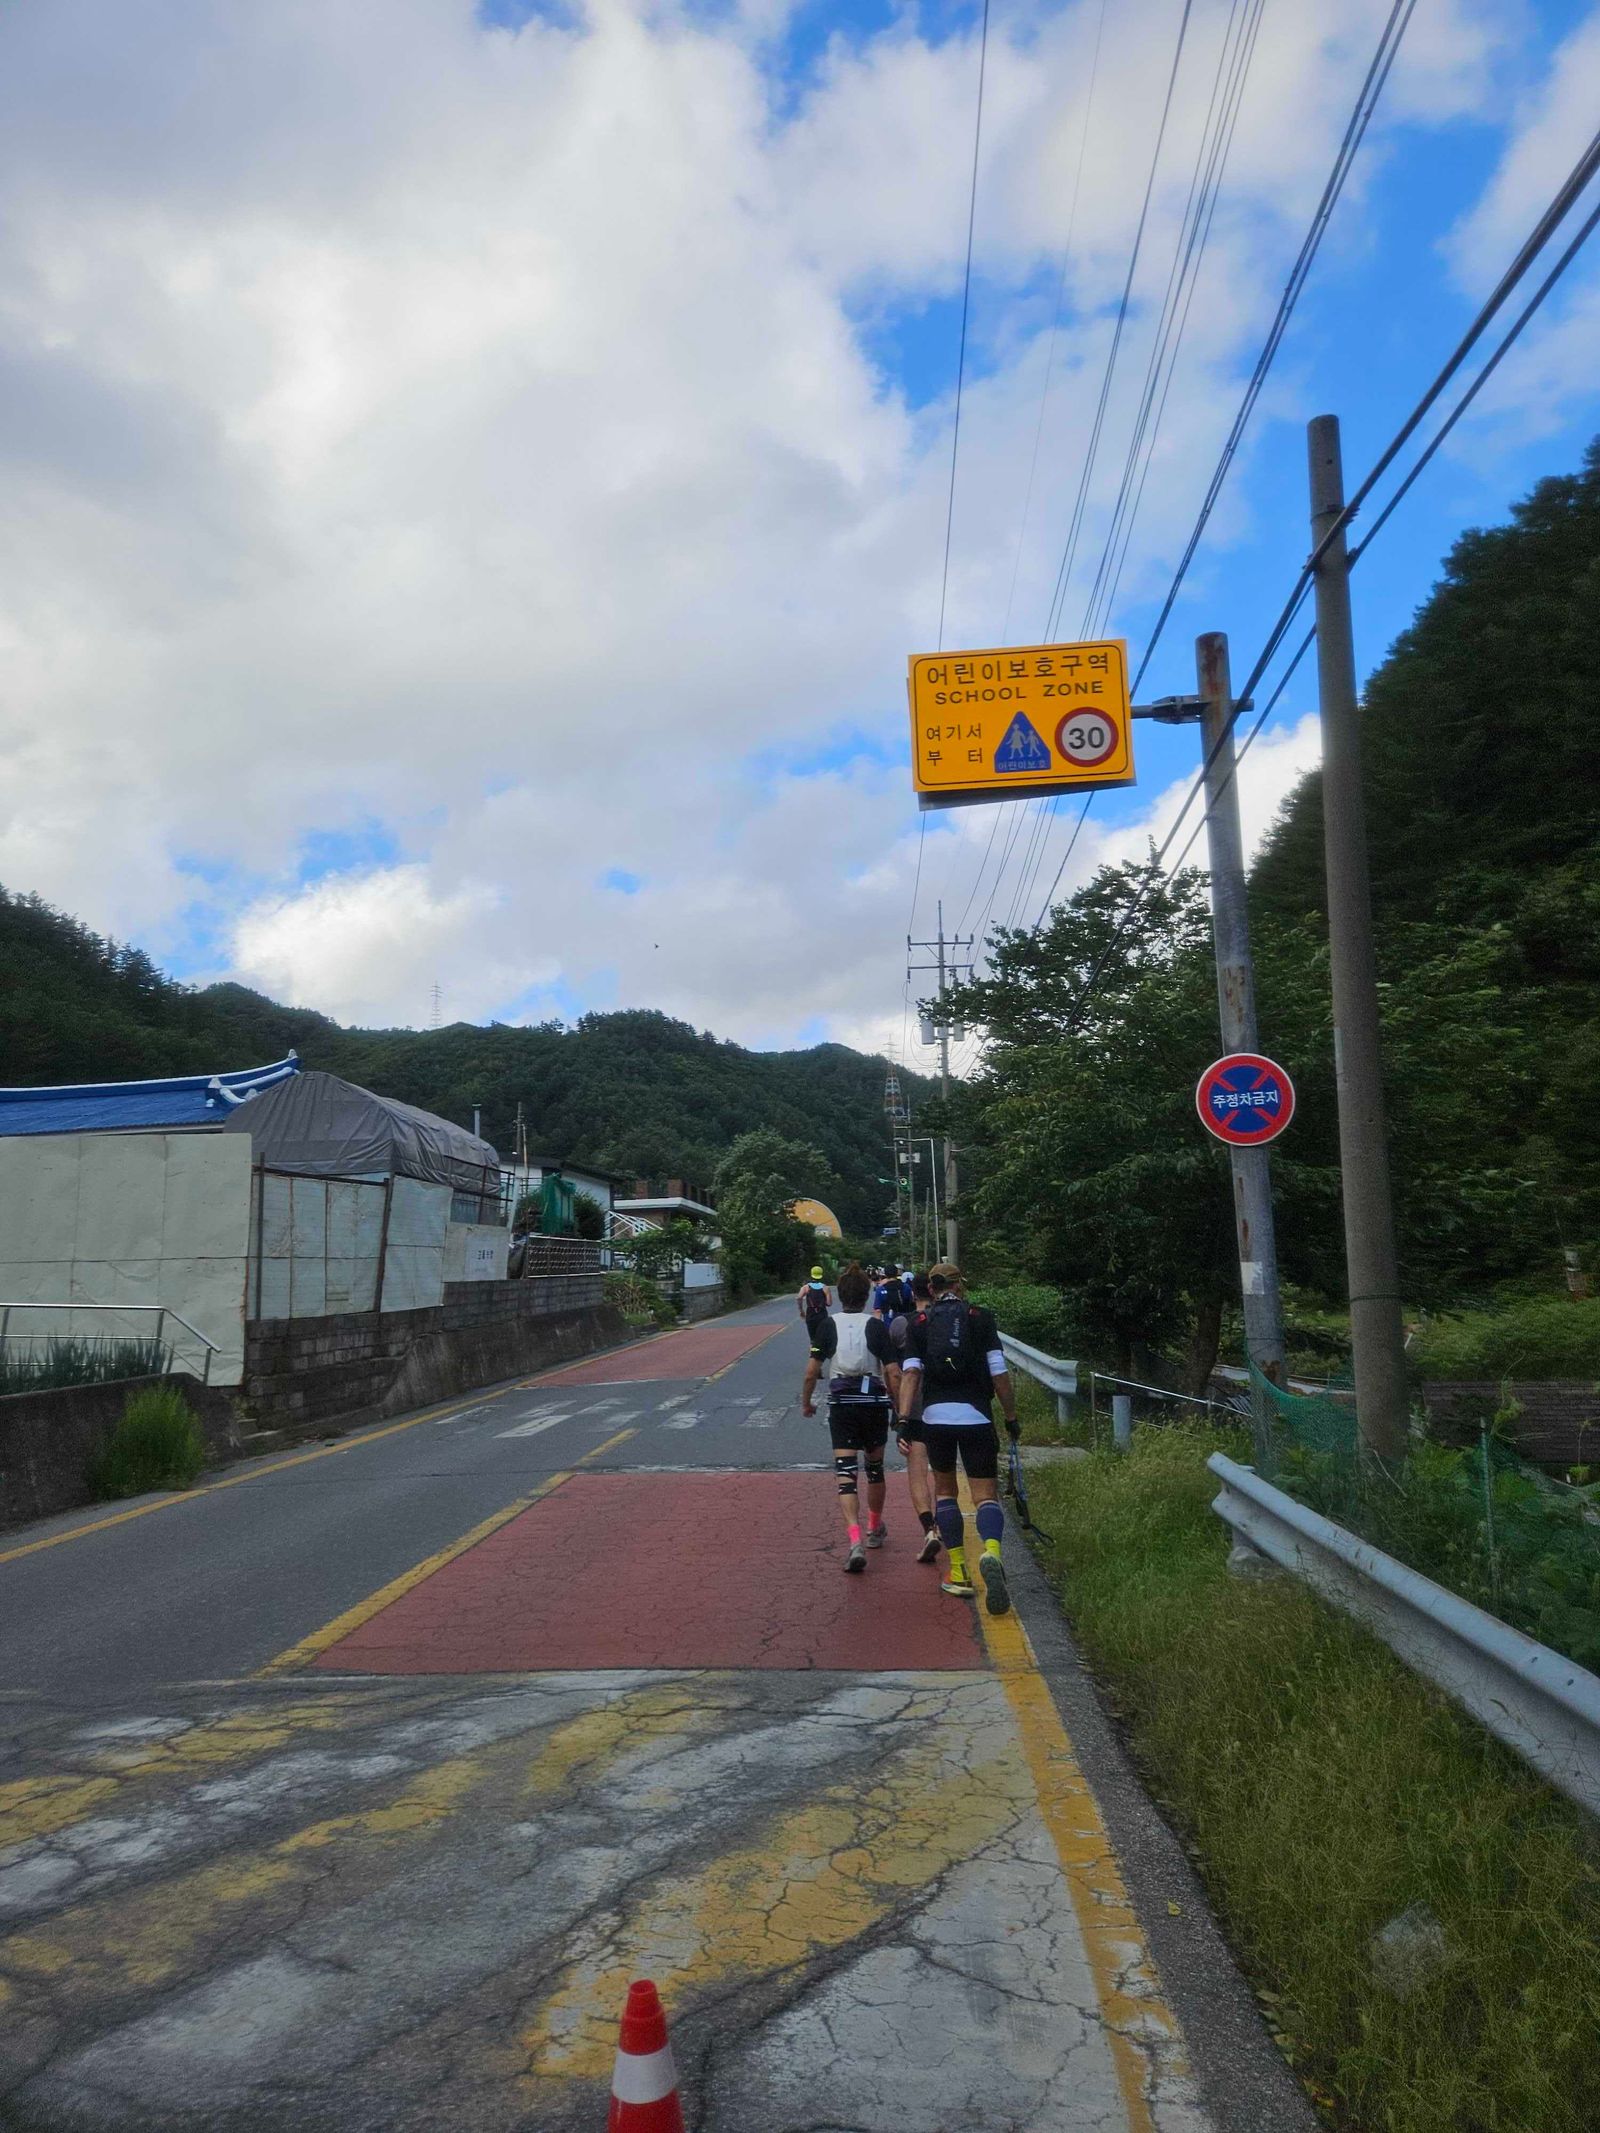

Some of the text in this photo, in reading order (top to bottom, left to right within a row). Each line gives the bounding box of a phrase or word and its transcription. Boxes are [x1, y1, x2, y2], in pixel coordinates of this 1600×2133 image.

[927, 652, 1109, 686] 어린이보호구역
[935, 681, 1104, 705] SCHOOL ZONE
[926, 723, 982, 742] 여기서
[1068, 726, 1104, 750] 30
[1213, 1089, 1279, 1108] 주정차금지
